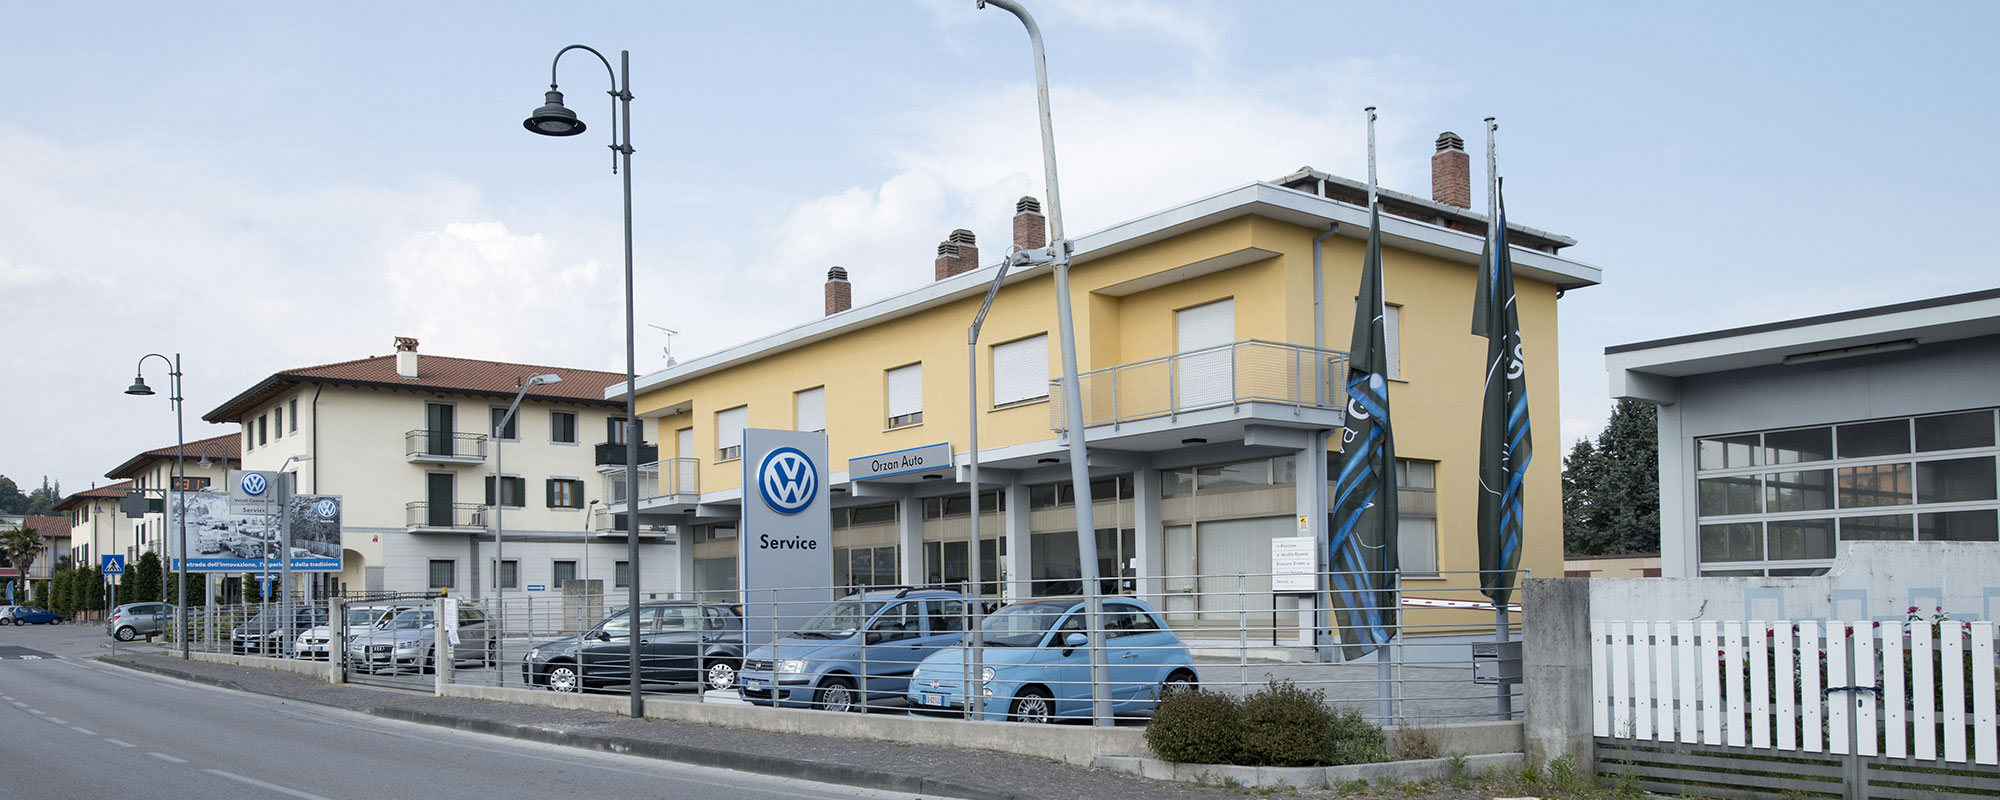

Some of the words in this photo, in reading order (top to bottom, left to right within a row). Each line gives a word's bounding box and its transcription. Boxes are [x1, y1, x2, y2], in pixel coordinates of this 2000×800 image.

[871, 459, 899, 473] Orzan
[901, 455, 923, 468] Auto
[759, 533, 817, 550] Service
